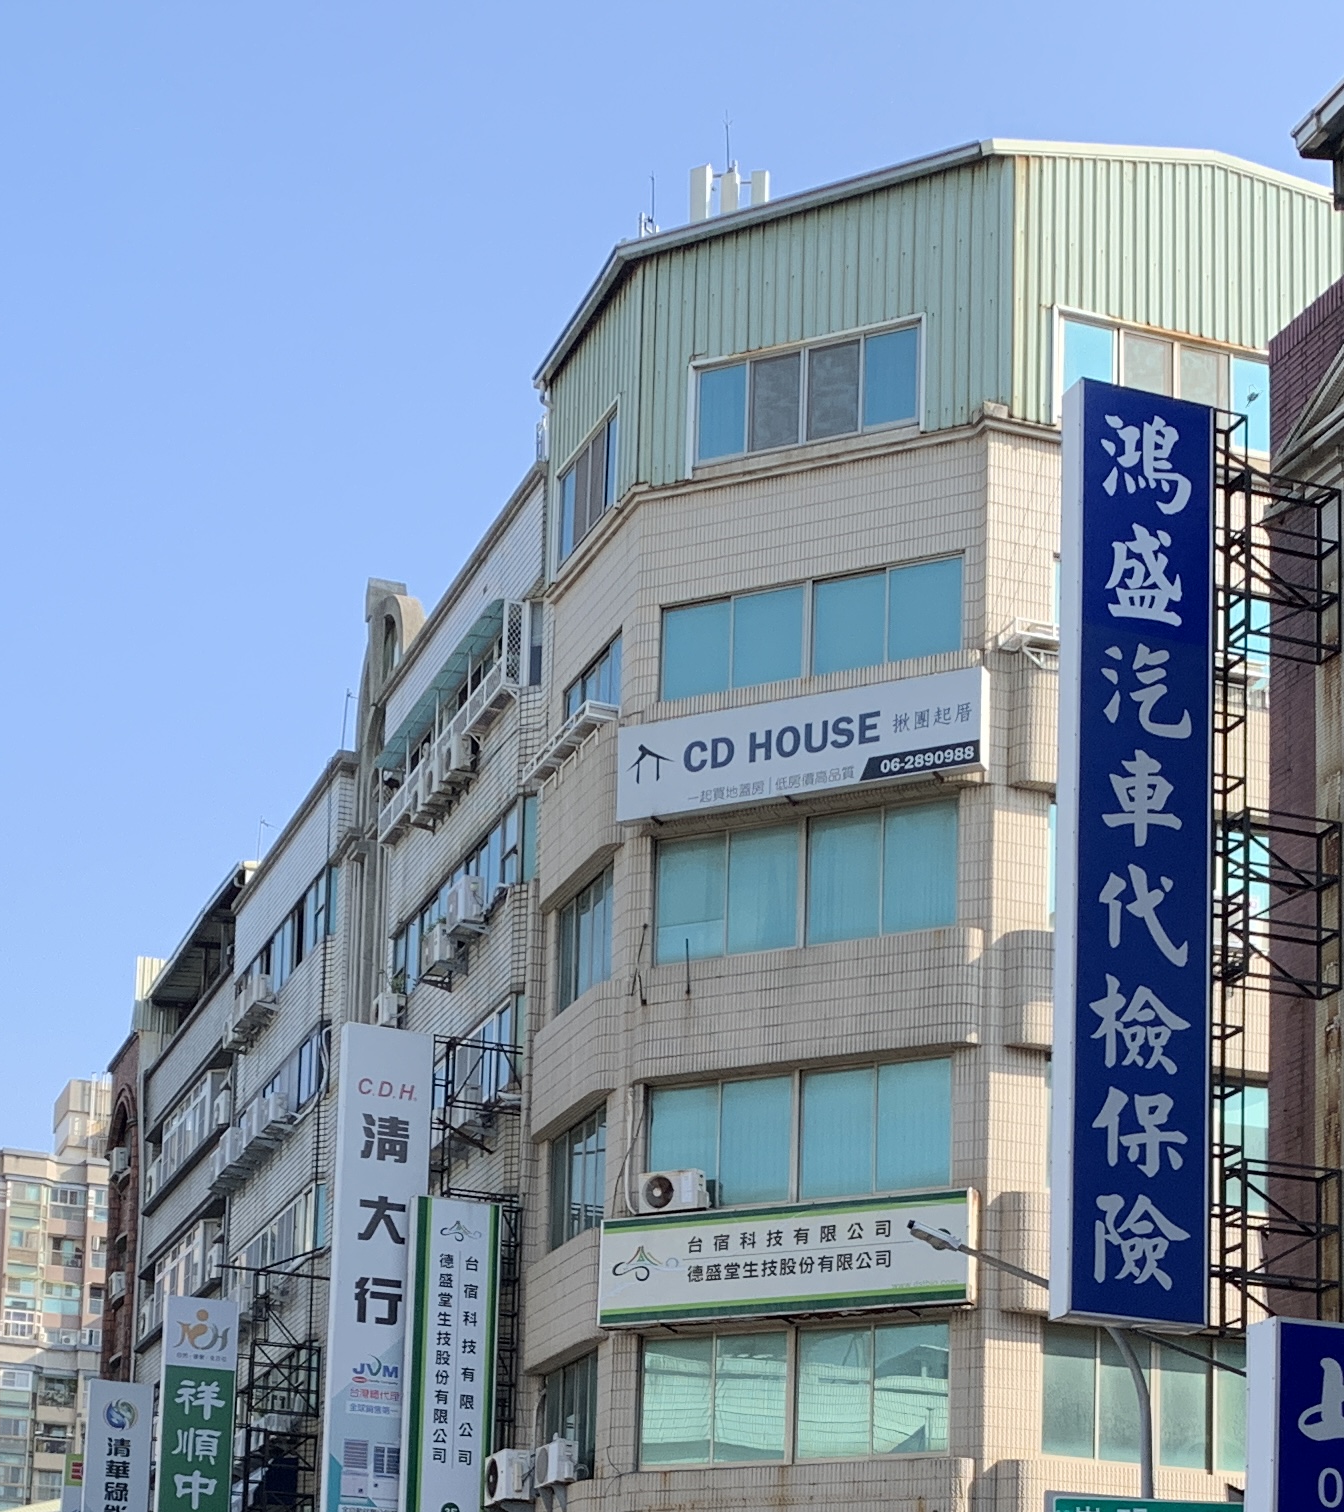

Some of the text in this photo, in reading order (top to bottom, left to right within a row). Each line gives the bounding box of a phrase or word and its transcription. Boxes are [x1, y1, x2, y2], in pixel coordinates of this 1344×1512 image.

[683, 736, 734, 773] CD
[749, 710, 880, 764] HOUSE
[880, 746, 975, 774] 06-2890988
[1089, 414, 1192, 1291] 鴻盛汽車代檢保險
[354, 1112, 410, 1326] 清大行
[687, 1219, 892, 1253] 台宿科技有限公司
[687, 1249, 892, 1284] 德盛堂生技股份有限公司
[352, 1354, 399, 1379] JVM
[432, 1253, 454, 1464] 德盛堂生技股份有限公司
[458, 1256, 479, 1466] 台宿科技有限公司
